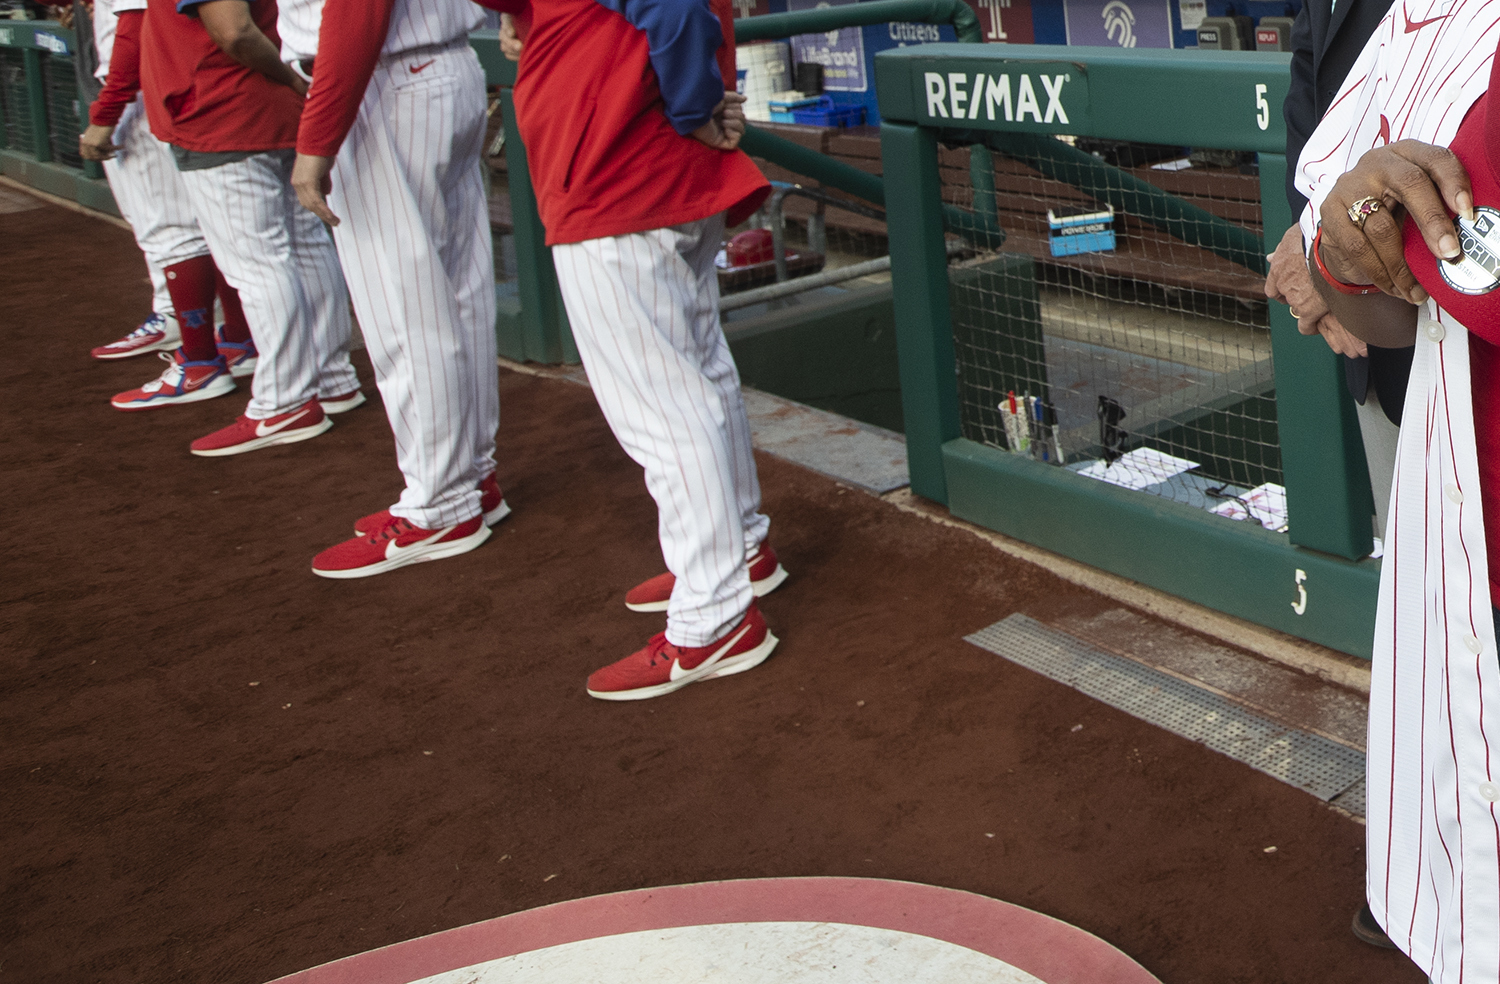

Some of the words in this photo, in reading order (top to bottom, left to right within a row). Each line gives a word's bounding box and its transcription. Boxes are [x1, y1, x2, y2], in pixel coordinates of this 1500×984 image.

[889, 22, 940, 42] Citizens
[1200, 32, 1217, 41] PRESS
[924, 72, 1069, 124] RE/MAX
[1255, 83, 1270, 131] 5
